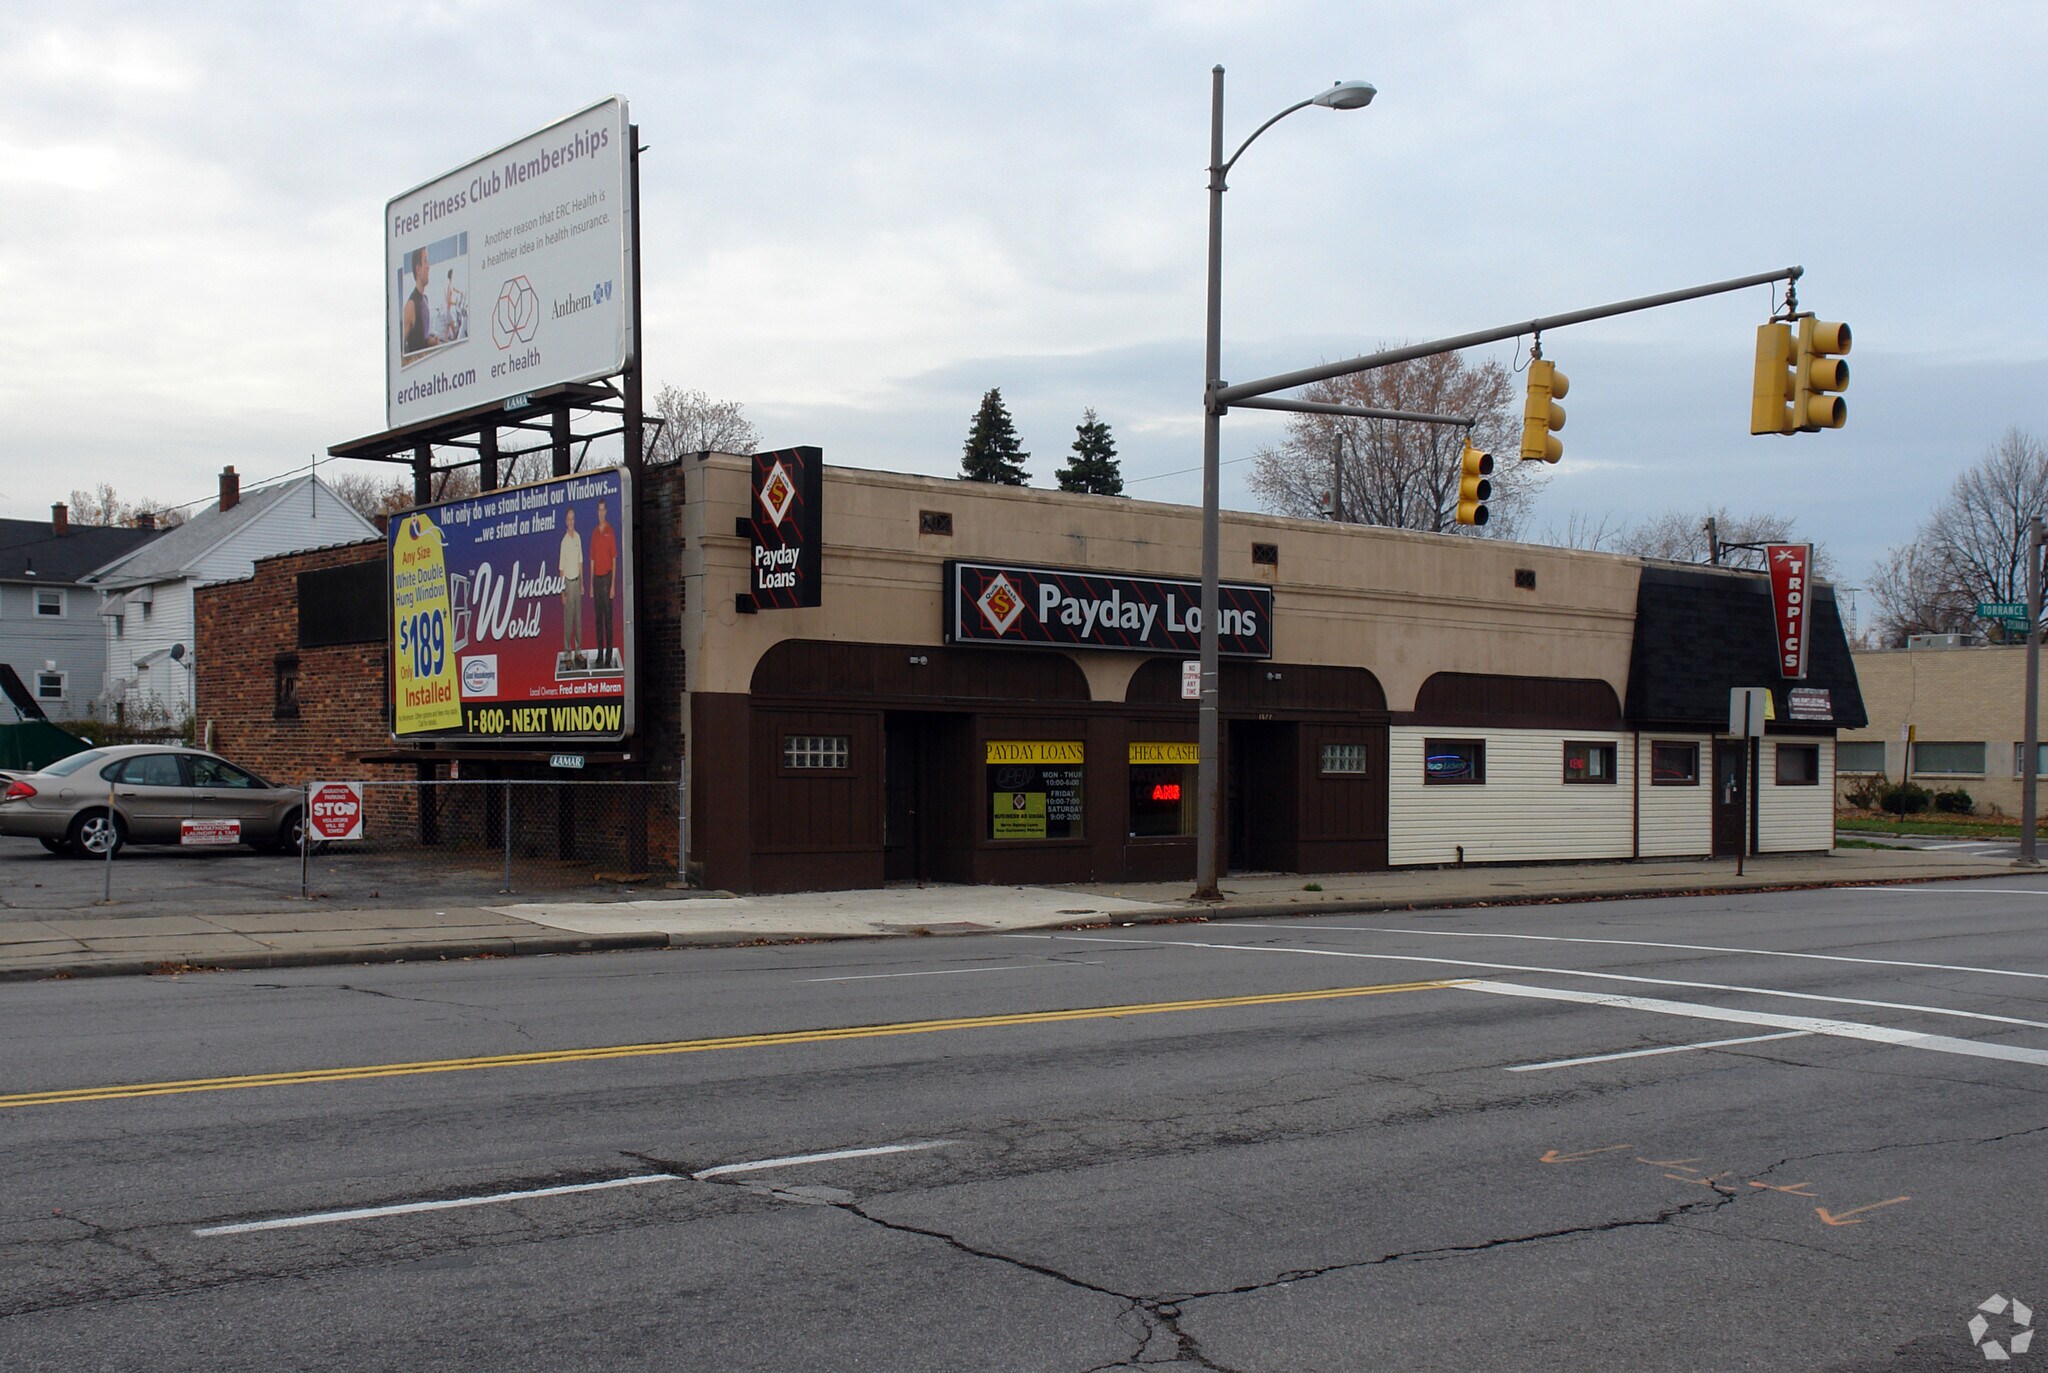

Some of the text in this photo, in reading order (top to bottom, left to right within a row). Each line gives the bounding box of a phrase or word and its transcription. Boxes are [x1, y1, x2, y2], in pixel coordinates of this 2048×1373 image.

[394, 127, 609, 238] Free Fitness Club Memberships
[484, 189, 606, 248] Another reason that ERC Health is
[480, 260, 487, 271] a
[486, 245, 518, 269] healthier
[519, 237, 535, 255] idea
[536, 235, 544, 250] in
[545, 226, 569, 246] health
[551, 293, 593, 320] Anthem
[490, 347, 541, 379] erc health
[397, 367, 477, 405] erchealth.com
[766, 473, 777, 491] Quik
[441, 478, 618, 528] Not only do we stand behind our Windows...
[496, 519, 518, 540] stand
[519, 519, 530, 534] on
[531, 510, 556, 531] them!
[402, 546, 431, 566] Any Size
[755, 543, 800, 571] Payday
[395, 563, 444, 590] White Double
[759, 568, 796, 589] Loans
[395, 583, 445, 609] Hung Window
[472, 560, 566, 642] Window
[985, 584, 999, 600] Quik
[1039, 583, 1158, 642] Payday
[1785, 560, 1803, 668] TROPICS
[1983, 605, 2024, 616] TORRANCE
[400, 665, 413, 682] Only
[405, 679, 452, 708] Installed
[559, 684, 573, 695] Fred
[574, 683, 586, 694] and
[588, 683, 598, 693] Pat
[600, 682, 622, 693] Moran
[551, 705, 622, 732] WINDOW
[553, 756, 581, 767] LAMAR
[985, 744, 1083, 760] PAYDAY LOANS
[1042, 771, 1058, 779] MON
[314, 802, 358, 817] STOP
